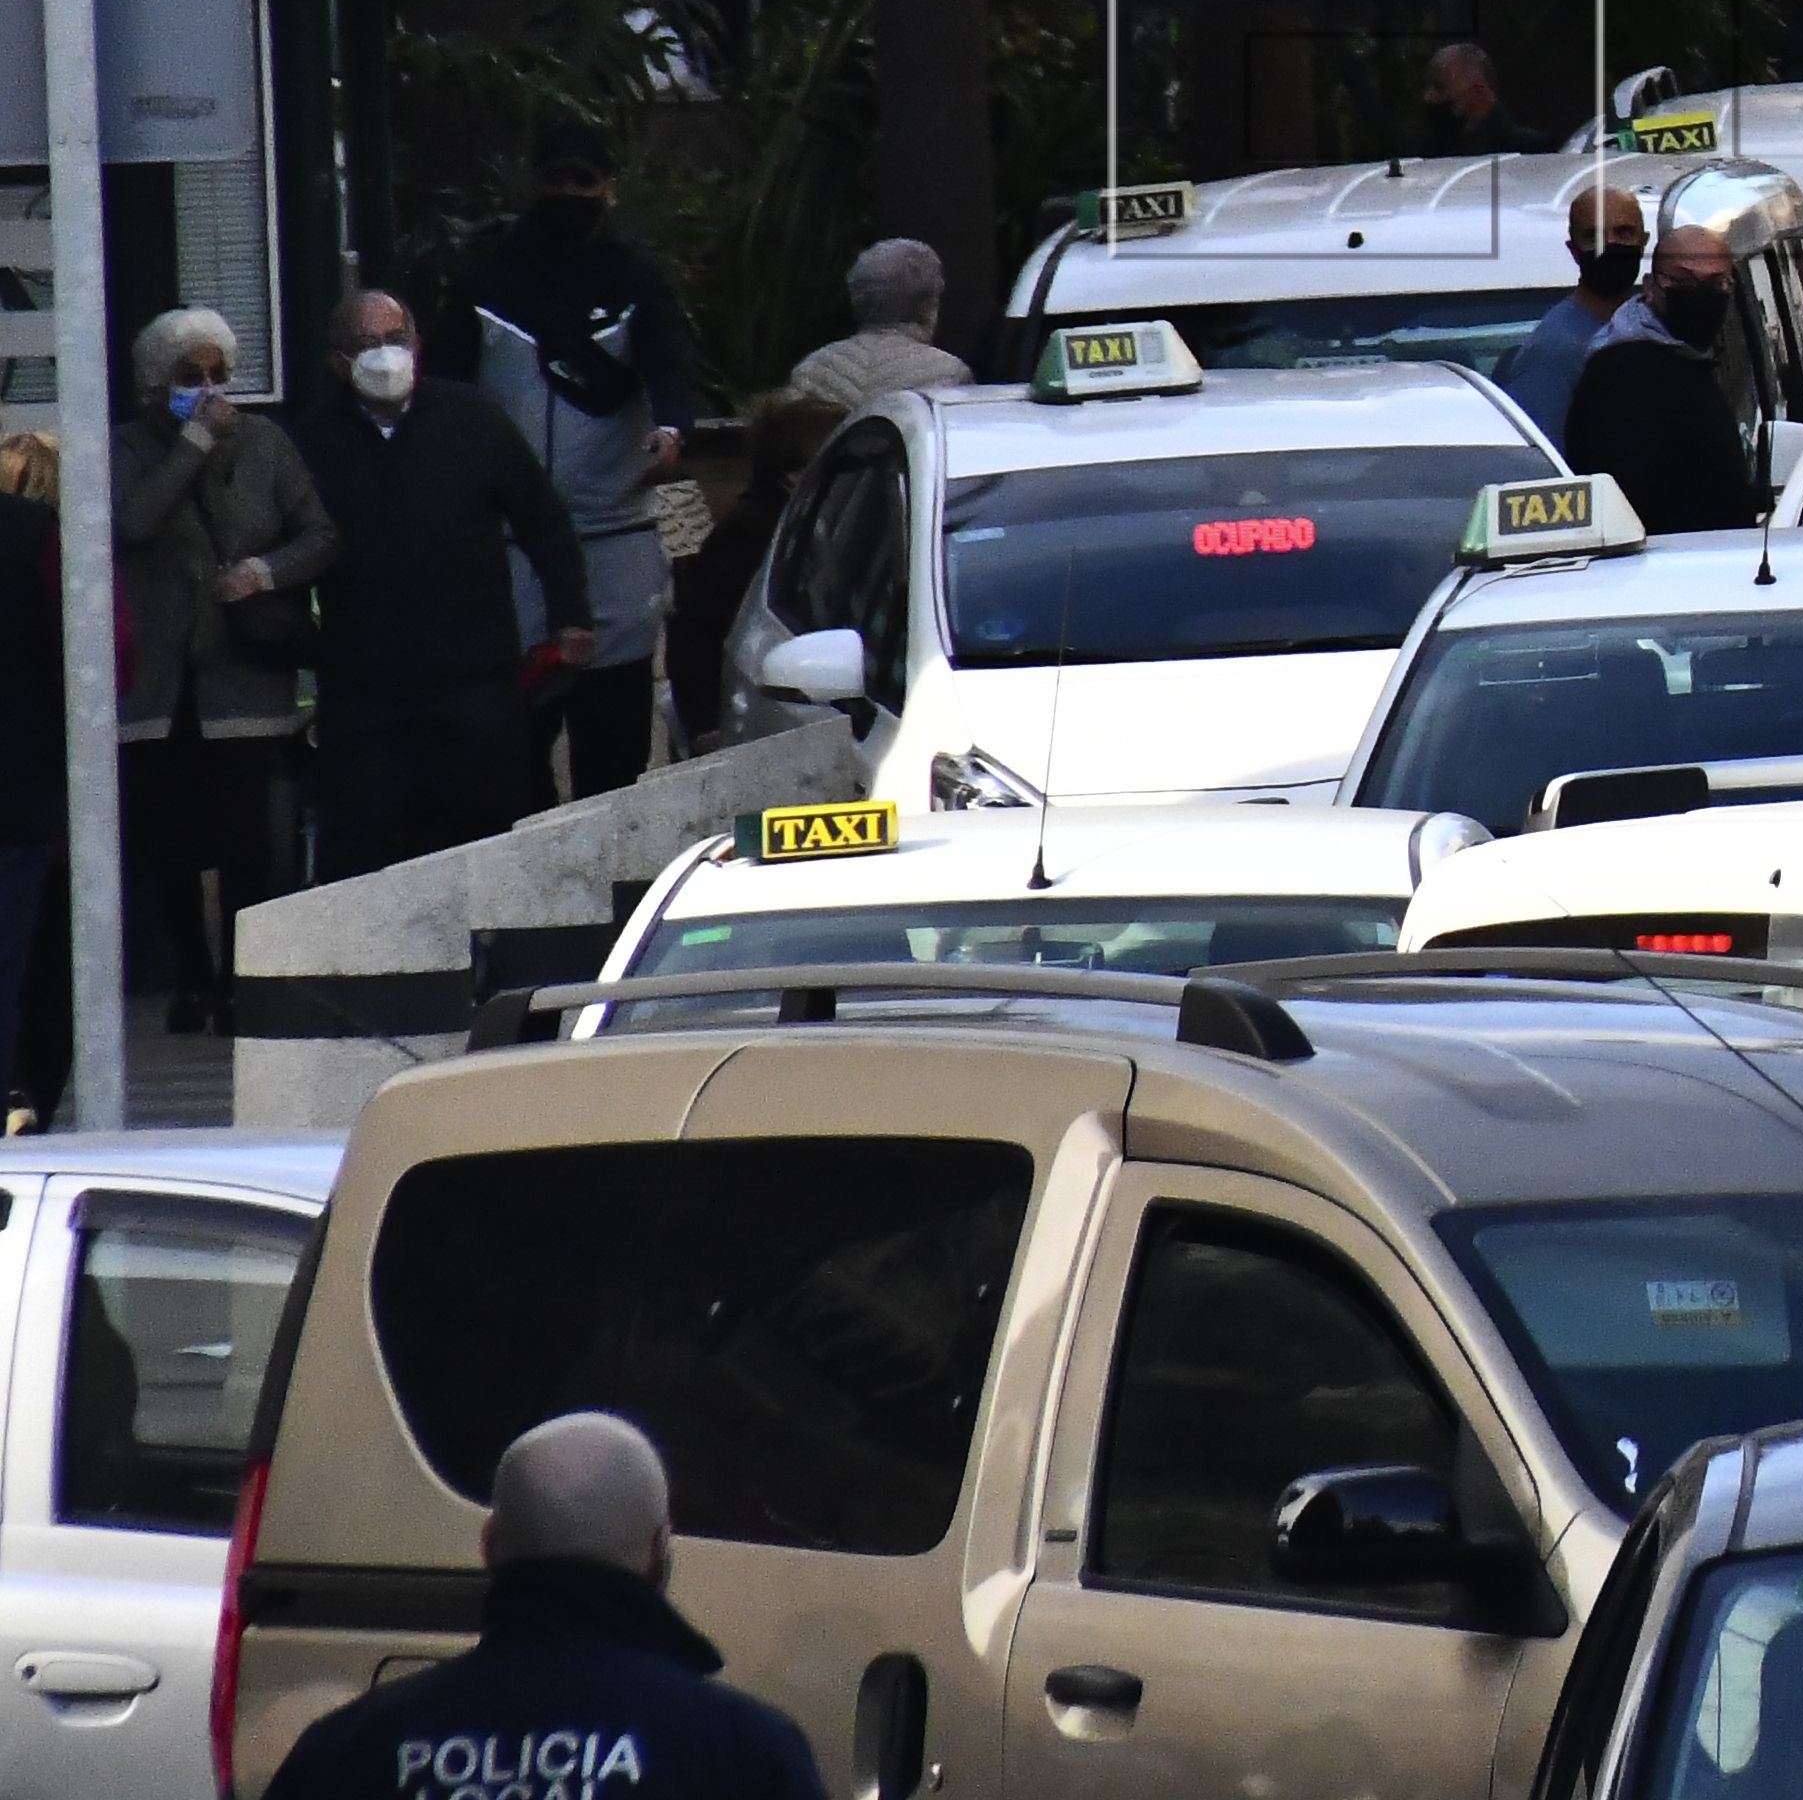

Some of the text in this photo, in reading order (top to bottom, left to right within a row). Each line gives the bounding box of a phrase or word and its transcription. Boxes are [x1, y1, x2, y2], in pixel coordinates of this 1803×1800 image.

[1640, 127, 1710, 152] TAXI
[1071, 338, 1135, 364] TAXI
[1507, 490, 1587, 528] TAXI
[1193, 517, 1316, 555] OCUPADO
[772, 815, 882, 851] TAXI
[397, 1730, 641, 1788] POLICIA
